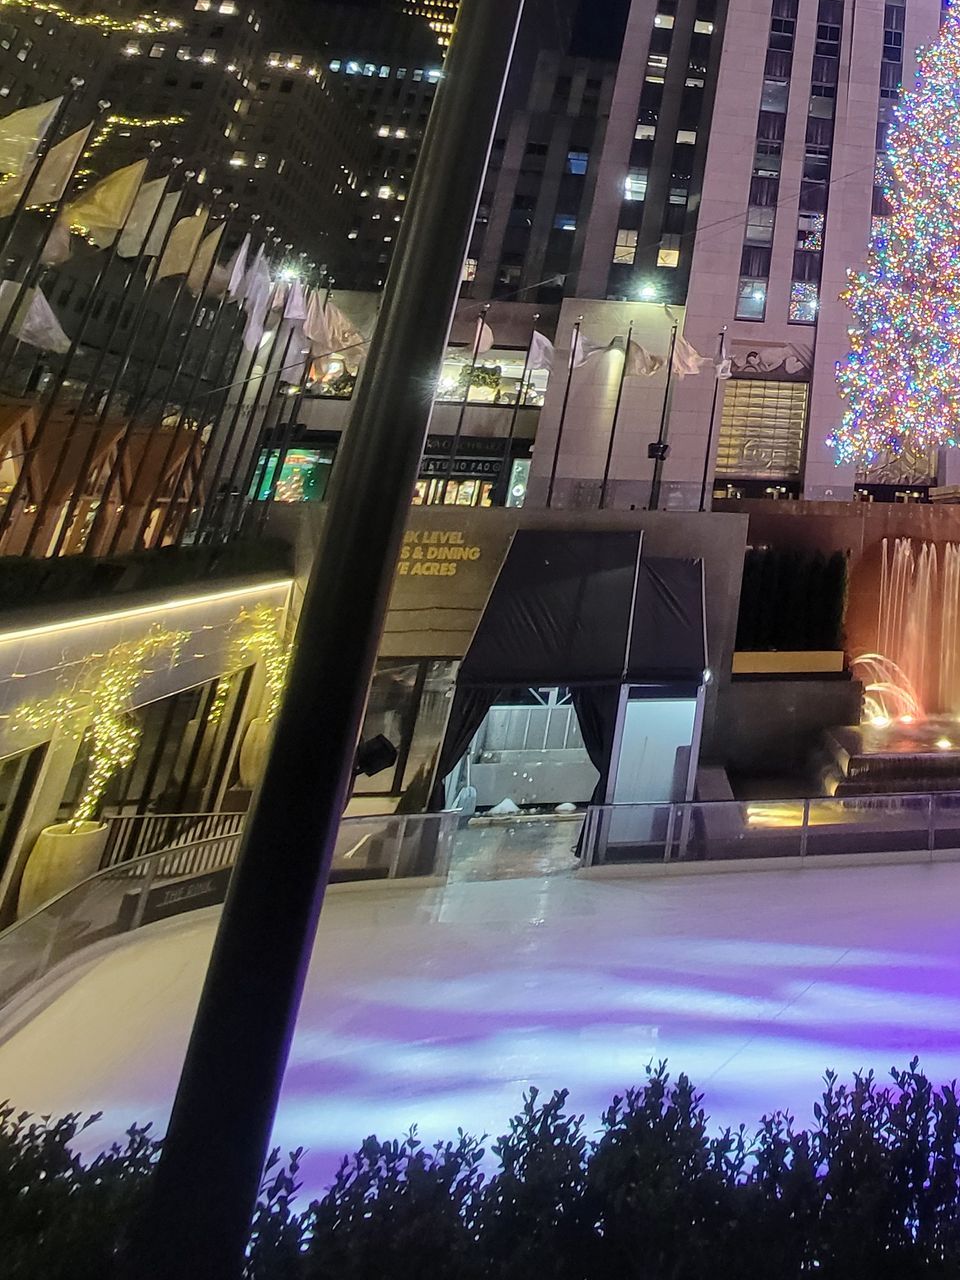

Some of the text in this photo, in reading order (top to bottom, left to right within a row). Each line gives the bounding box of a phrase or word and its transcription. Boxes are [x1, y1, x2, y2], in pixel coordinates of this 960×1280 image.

[422, 531, 464, 544] LEVEL
[412, 546, 424, 559] &
[427, 546, 480, 560] DINING
[411, 562, 457, 575] ACRES
